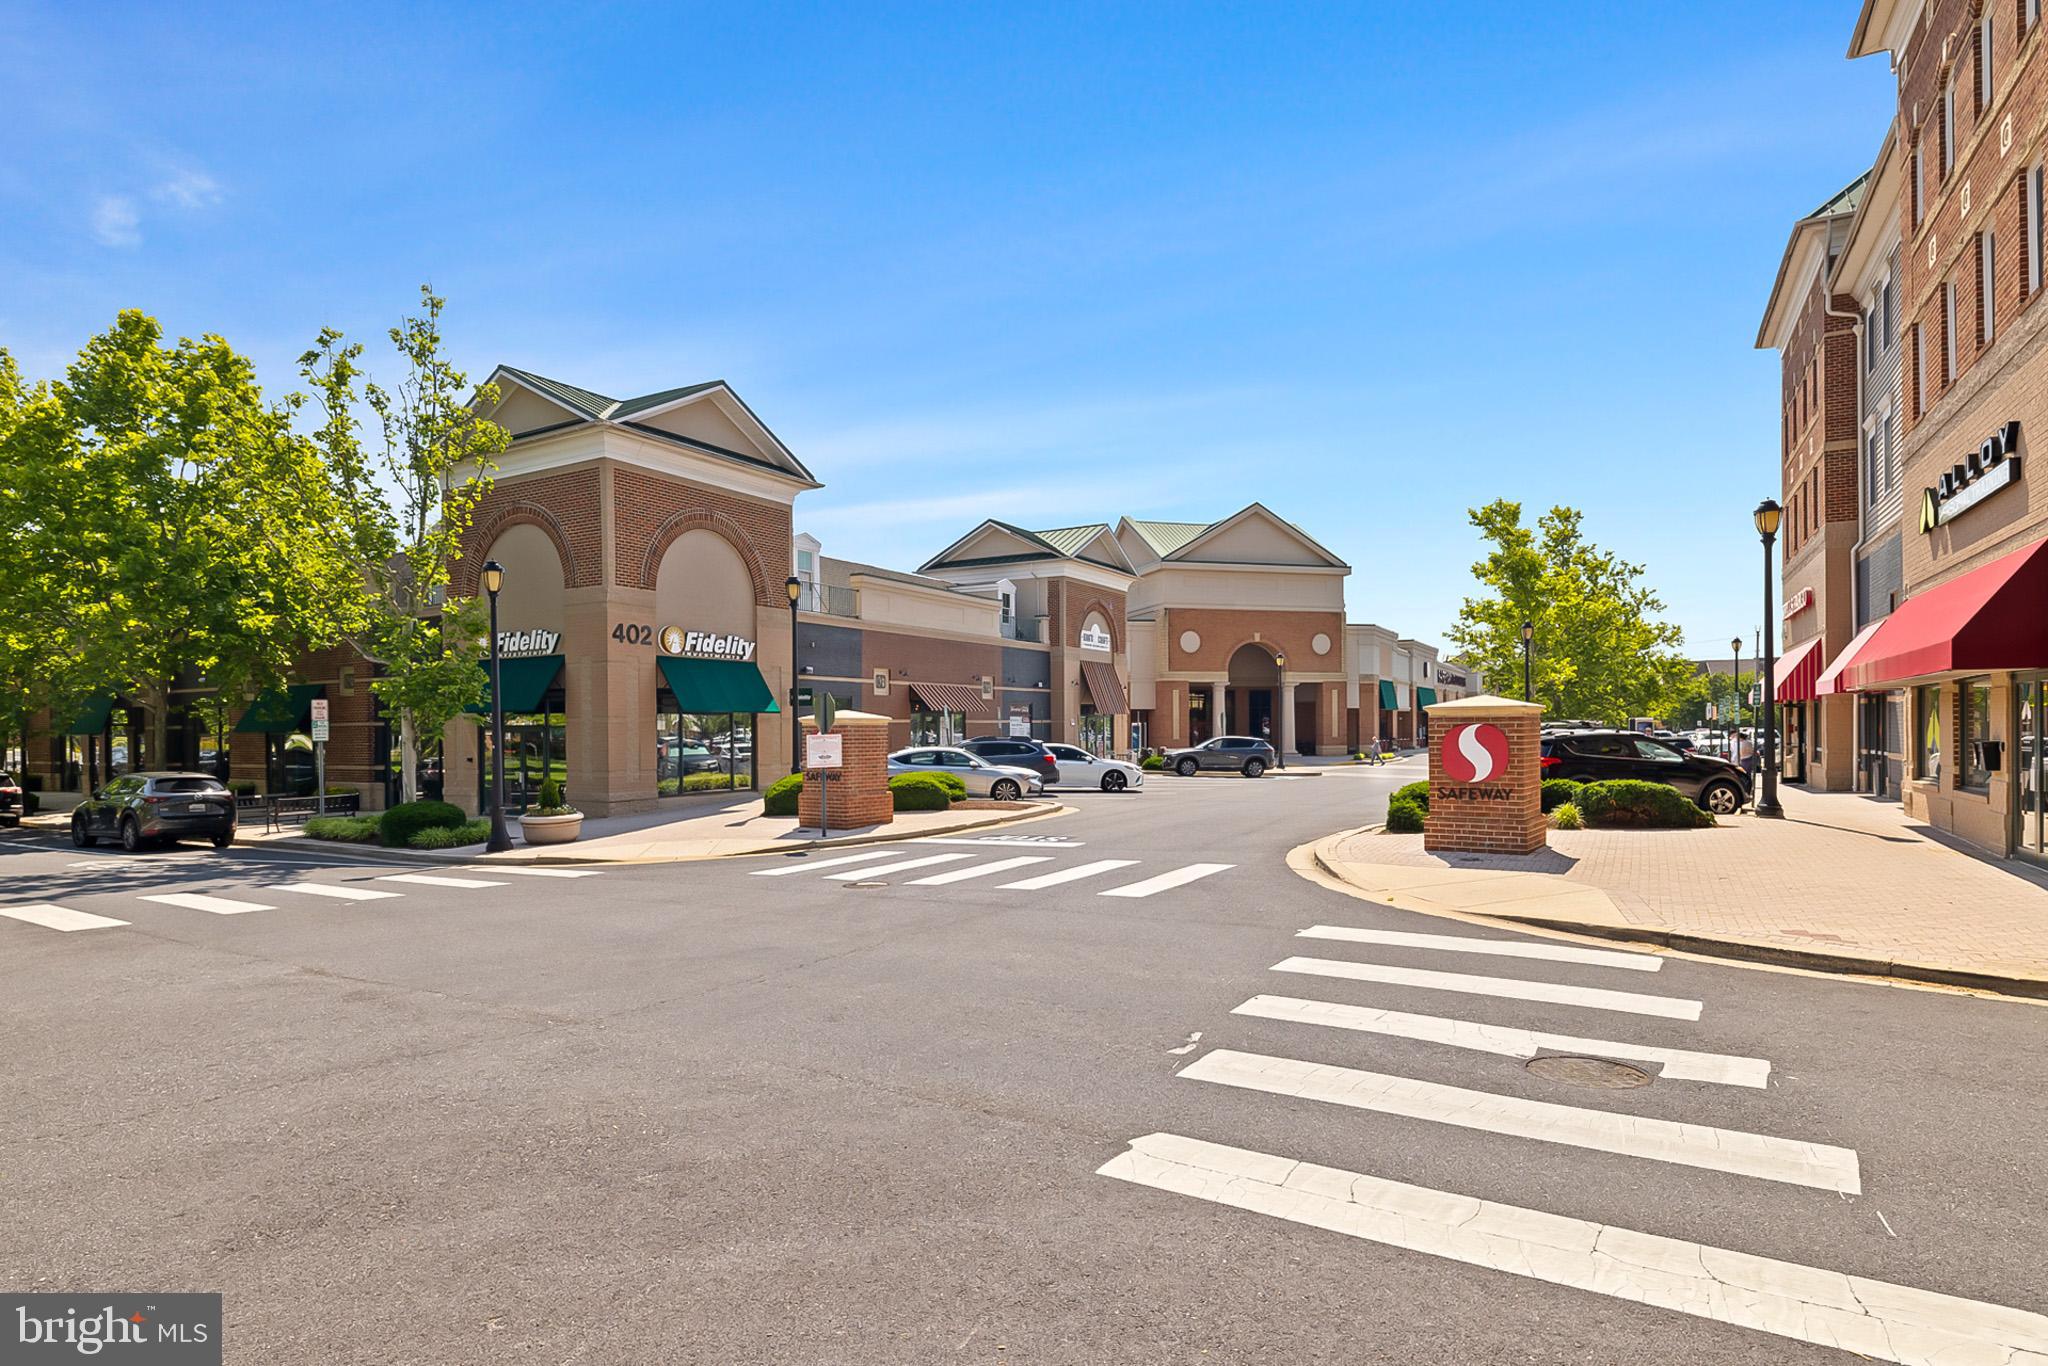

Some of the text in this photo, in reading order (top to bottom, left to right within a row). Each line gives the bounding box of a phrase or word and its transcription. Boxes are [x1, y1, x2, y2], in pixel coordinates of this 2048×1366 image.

[1938, 421, 2020, 500] ALLOY
[497, 630, 560, 655] Fidelity
[612, 623, 653, 646] 402
[684, 631, 756, 660] Fidelity
[806, 770, 842, 781] SAFWAY
[1438, 786, 1514, 801] SAFEWAY
